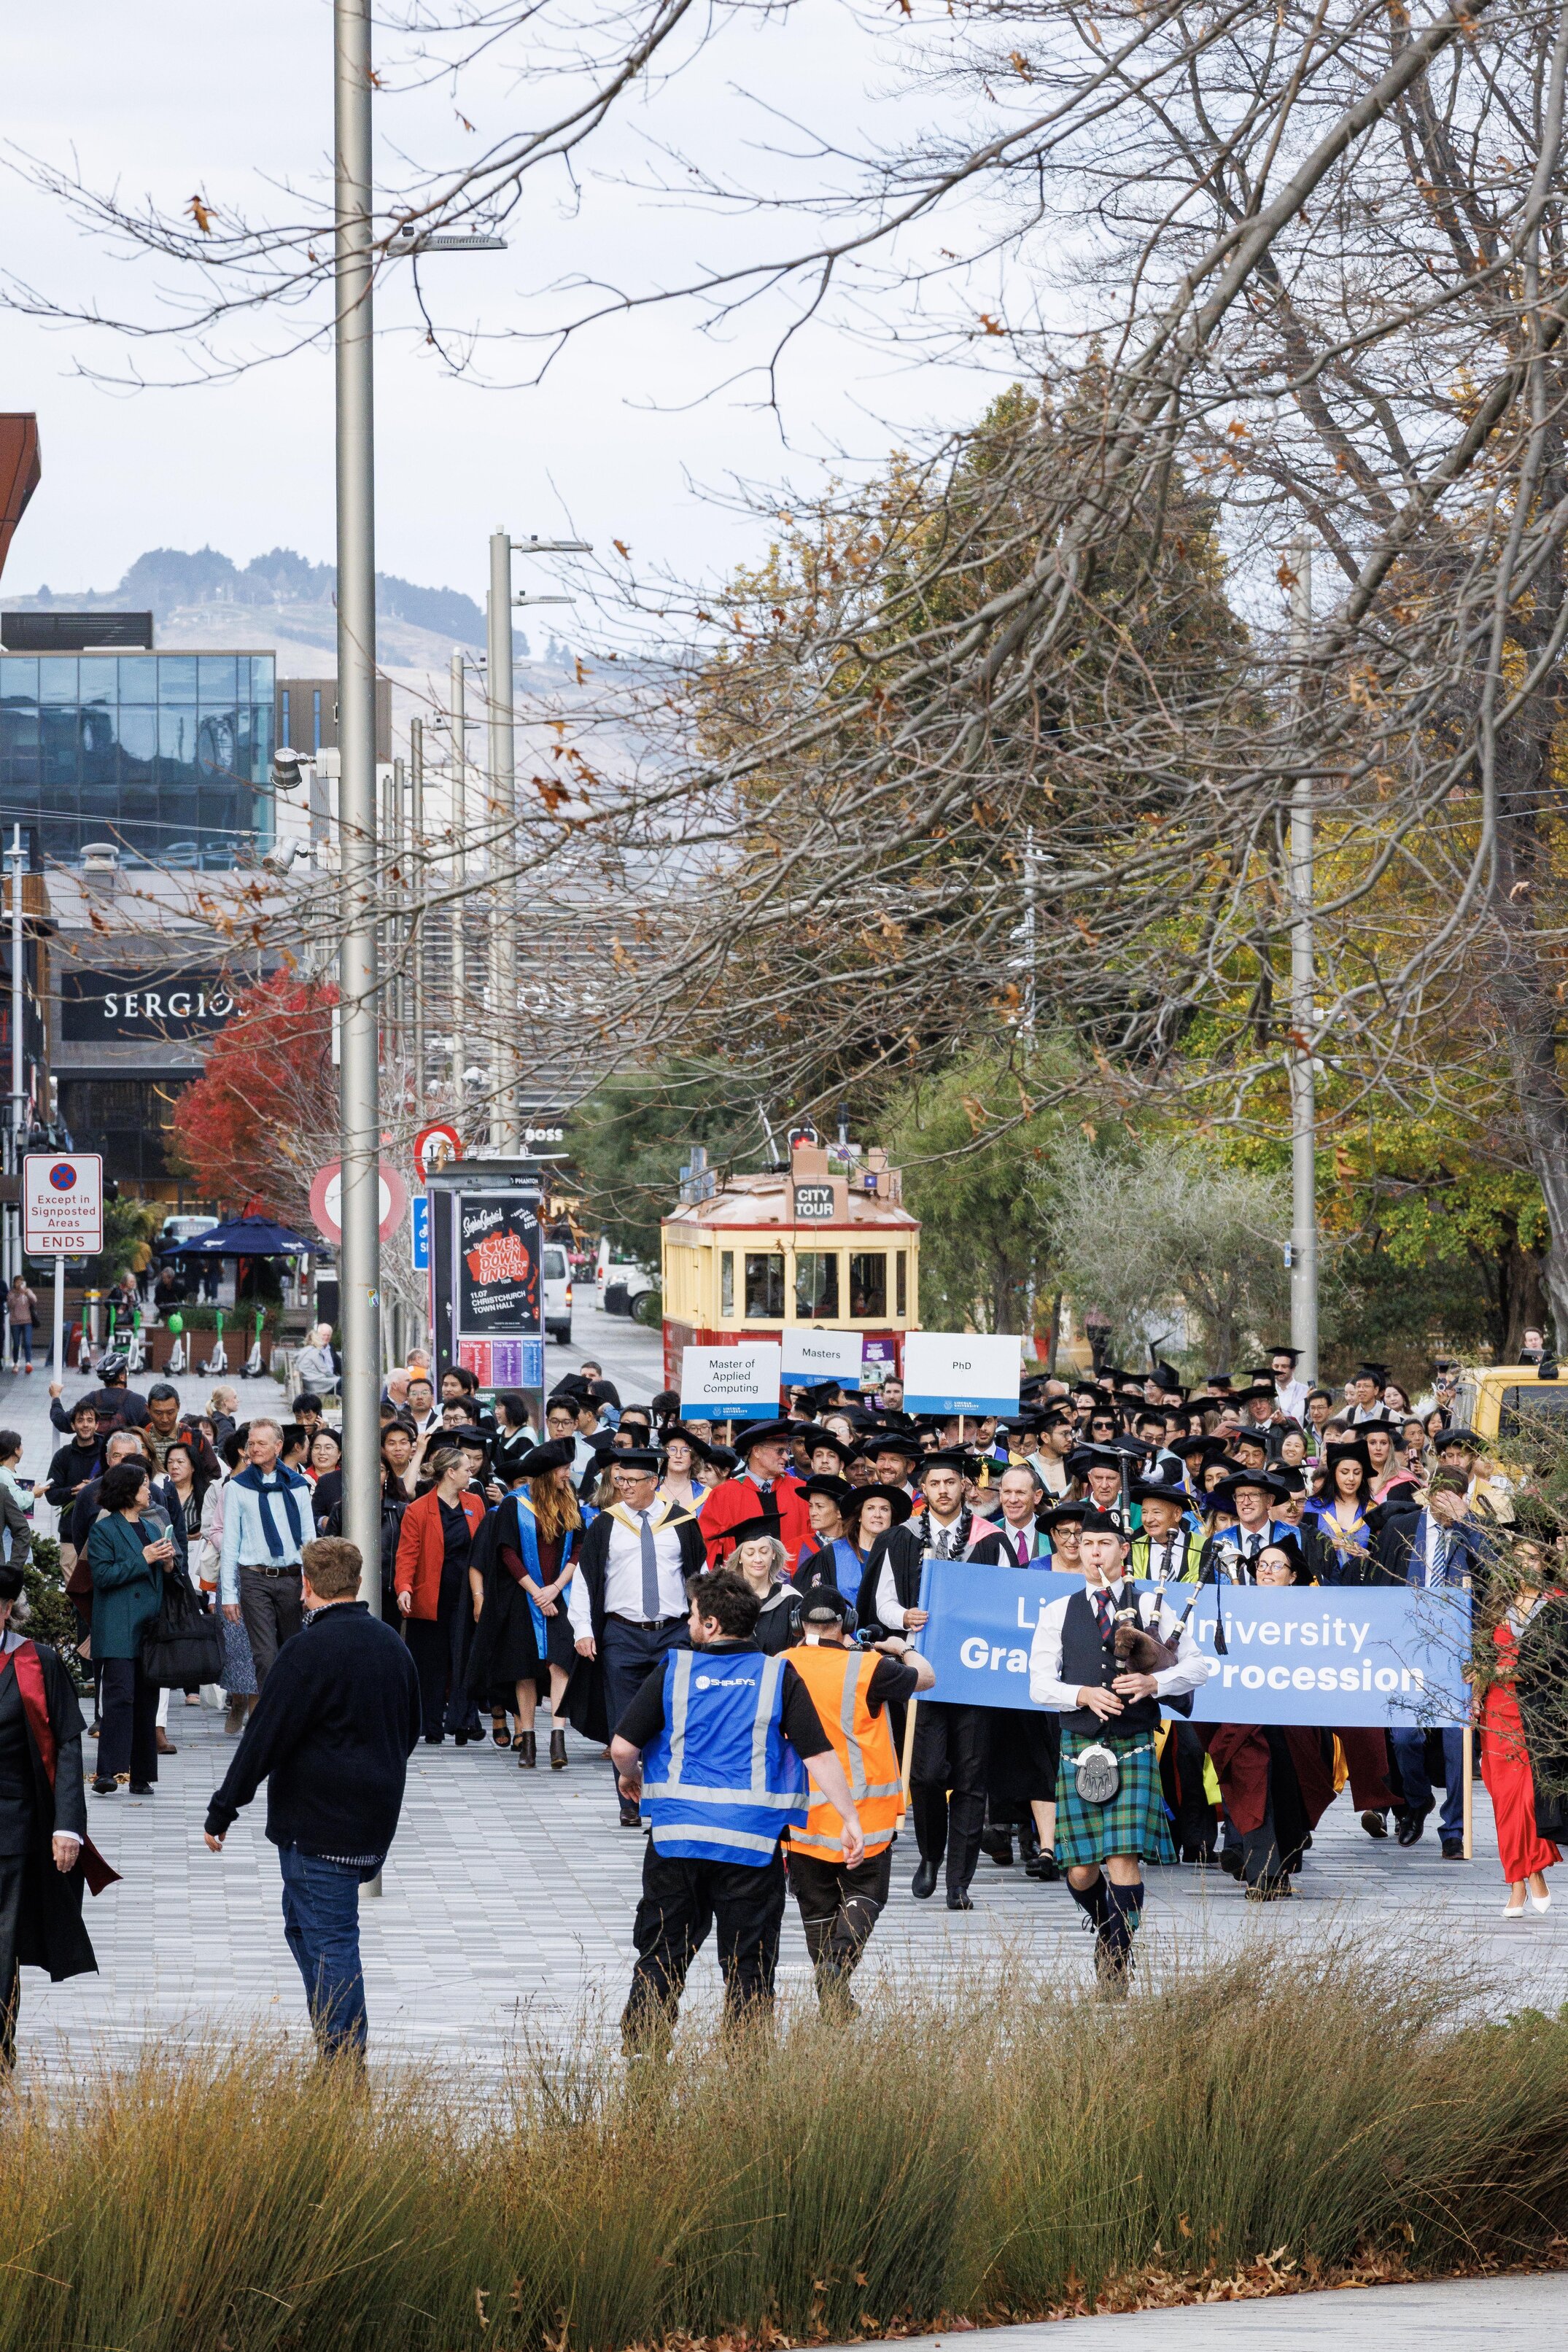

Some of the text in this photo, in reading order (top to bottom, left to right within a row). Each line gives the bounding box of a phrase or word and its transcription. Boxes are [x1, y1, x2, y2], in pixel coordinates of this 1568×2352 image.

[525, 1129, 564, 1141] BOSS
[38, 1195, 90, 1206] Except in
[798, 1189, 829, 1201] CITY
[31, 1207, 96, 1217] Signposted
[796, 1203, 834, 1215] TOUR
[48, 1219, 79, 1227] Areas
[42, 1236, 85, 1247] ENDS
[480, 1249, 521, 1270] DOWN
[470, 1289, 487, 1299] 11.07
[471, 1290, 526, 1307] CHRISTCHURCH
[473, 1301, 515, 1314] TOWN HALL
[802, 1348, 841, 1359] Masters
[709, 1359, 756, 1368] Master of
[952, 1362, 971, 1370] PhD
[713, 1371, 750, 1382] Applied
[703, 1383, 758, 1394] Computing
[960, 1637, 1028, 1673] Gra
[710, 1678, 756, 1687] SHIPLEYS
